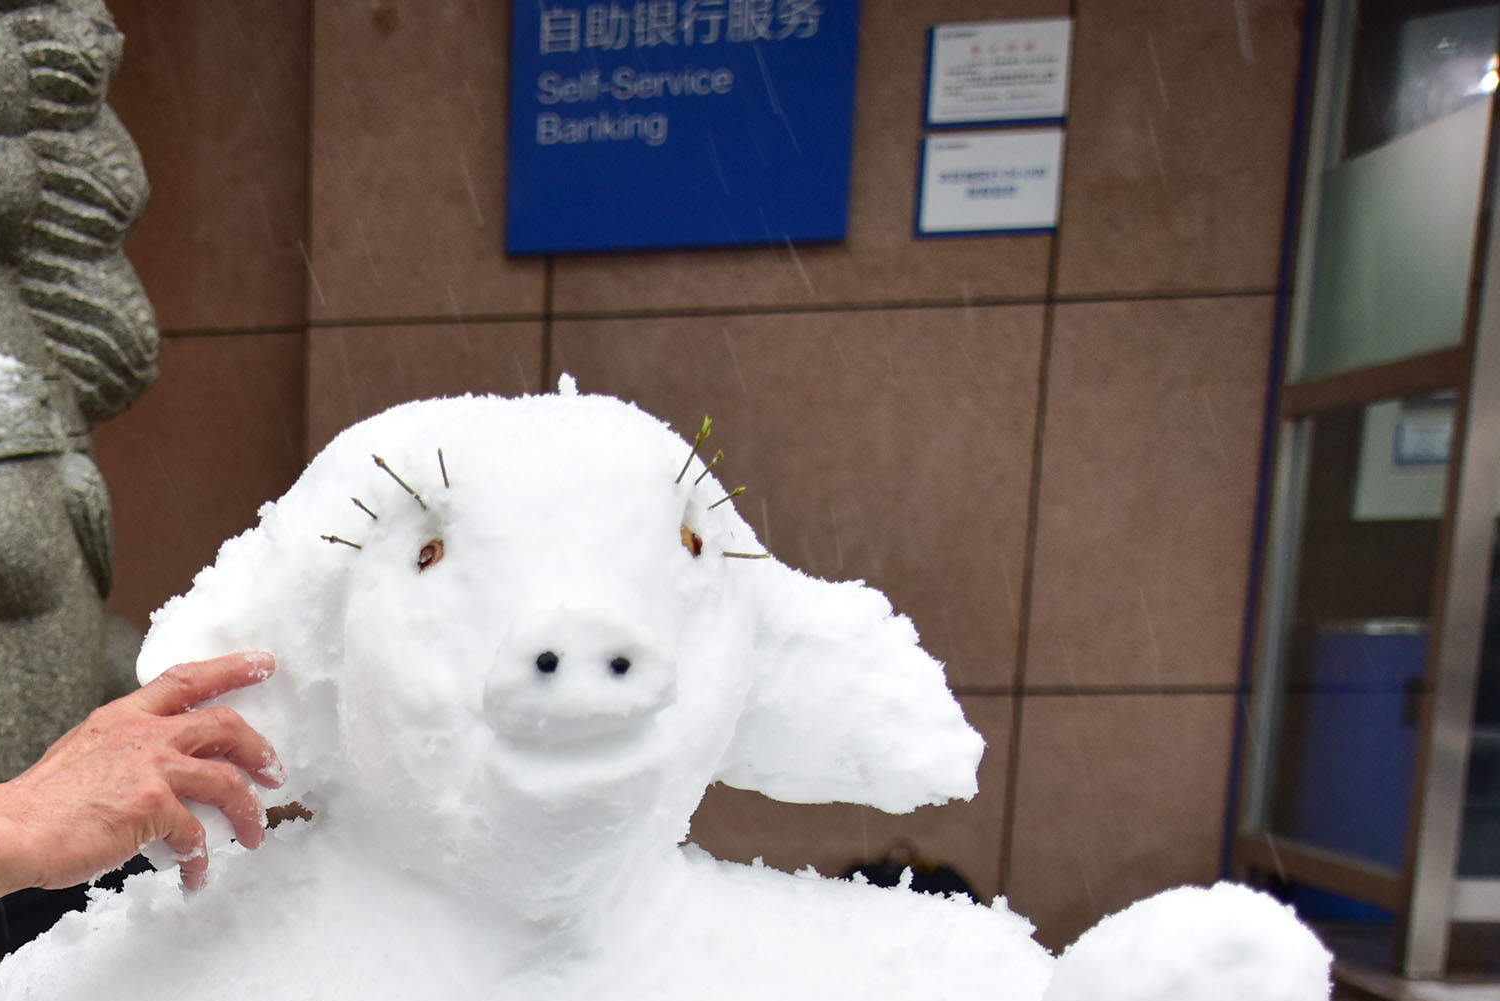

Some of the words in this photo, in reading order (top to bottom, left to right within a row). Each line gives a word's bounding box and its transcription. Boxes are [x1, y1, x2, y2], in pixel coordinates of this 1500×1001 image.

[539, 0, 824, 54] 自助银行服务
[537, 66, 734, 104] Self-Service
[536, 111, 668, 146] Banking
